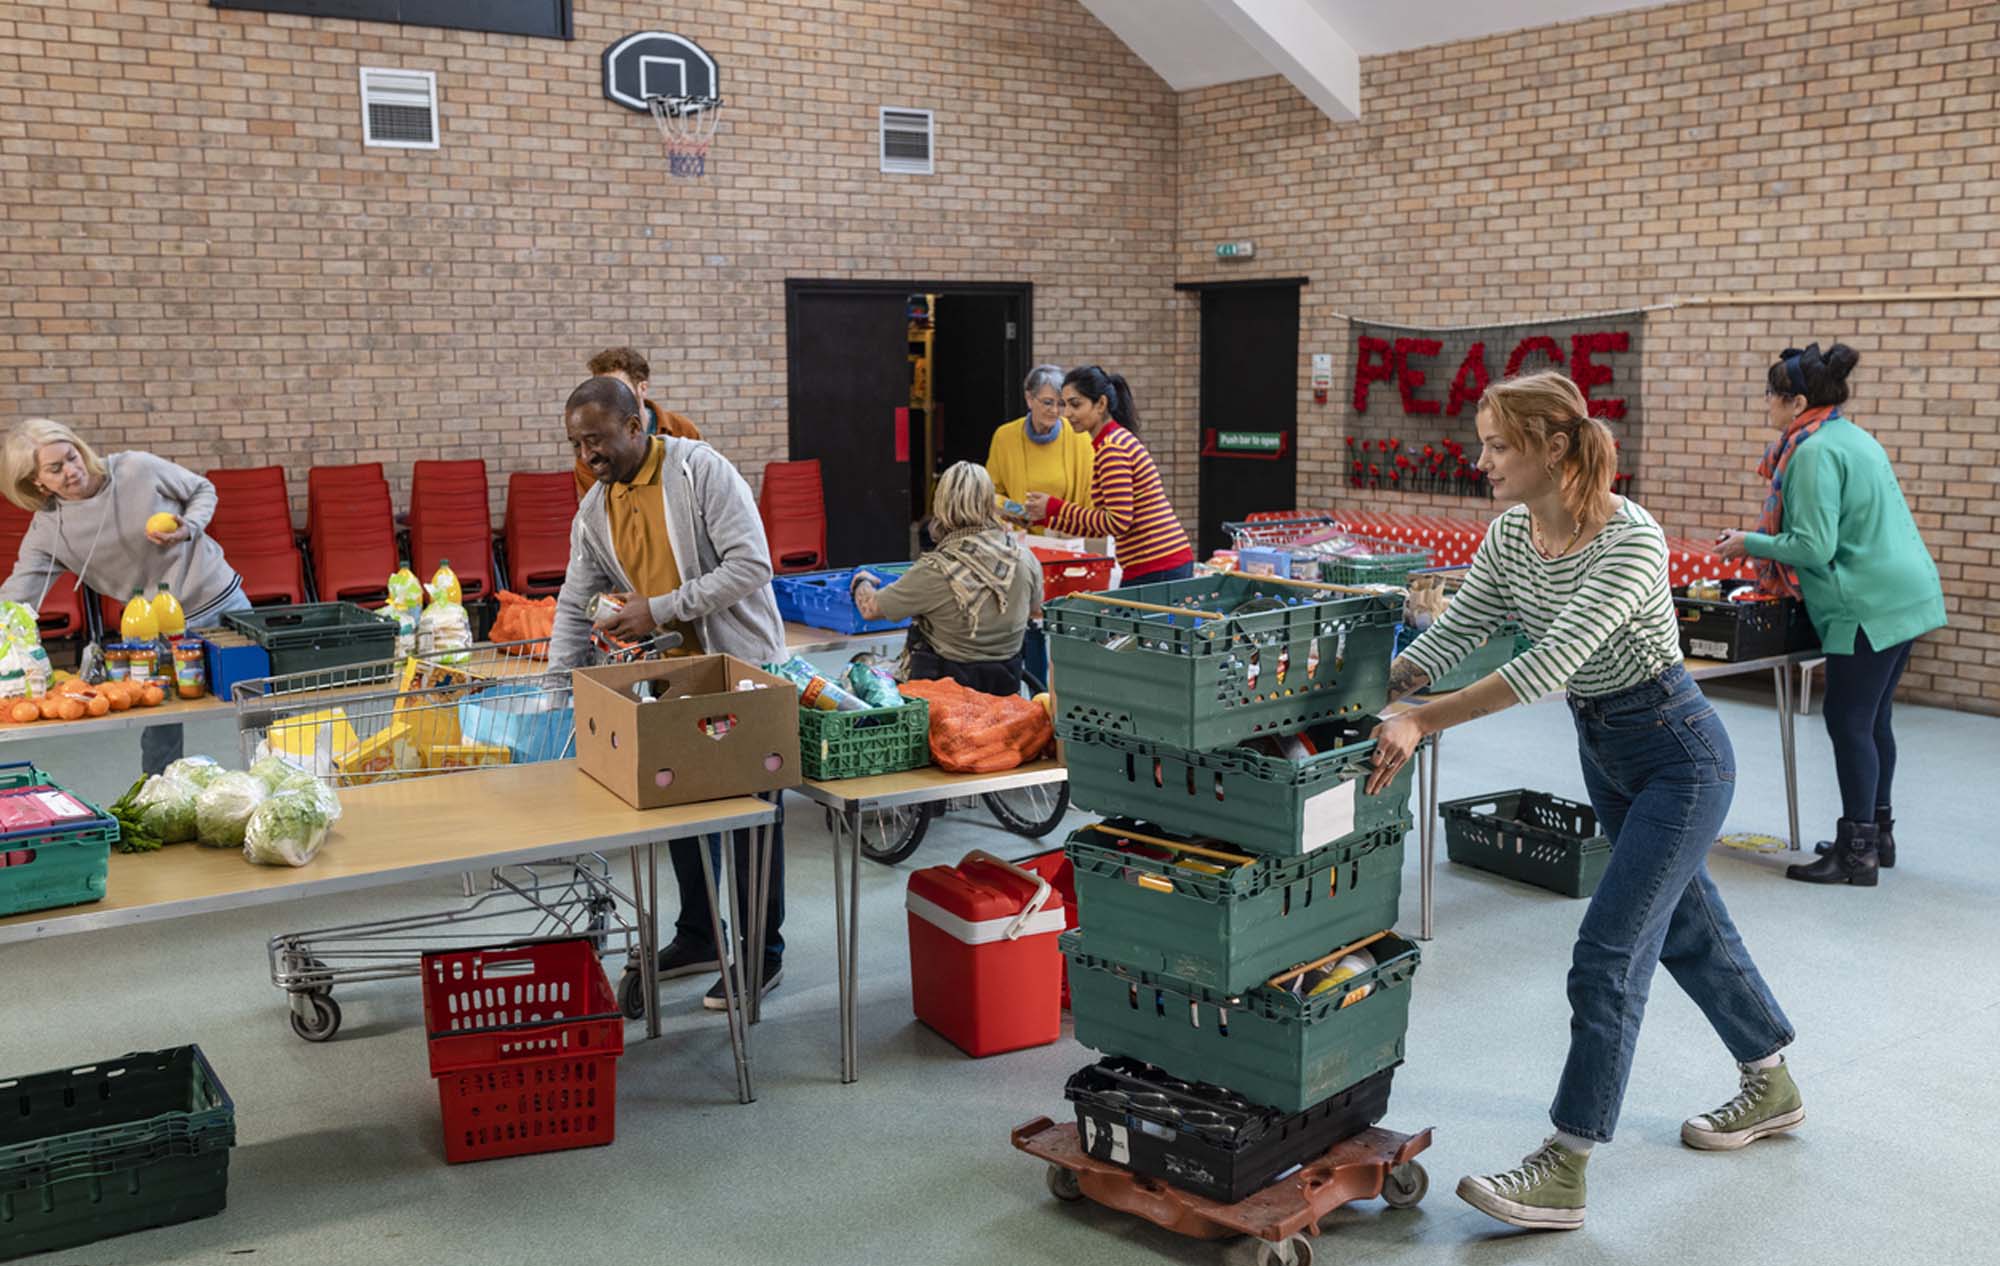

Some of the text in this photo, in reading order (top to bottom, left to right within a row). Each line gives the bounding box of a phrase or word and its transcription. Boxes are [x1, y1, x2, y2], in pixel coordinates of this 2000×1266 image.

[1353, 332, 1630, 420] PEACE
[1220, 434, 1238, 445] Push
[1252, 435, 1260, 445] to
[1261, 437, 1280, 447] open
